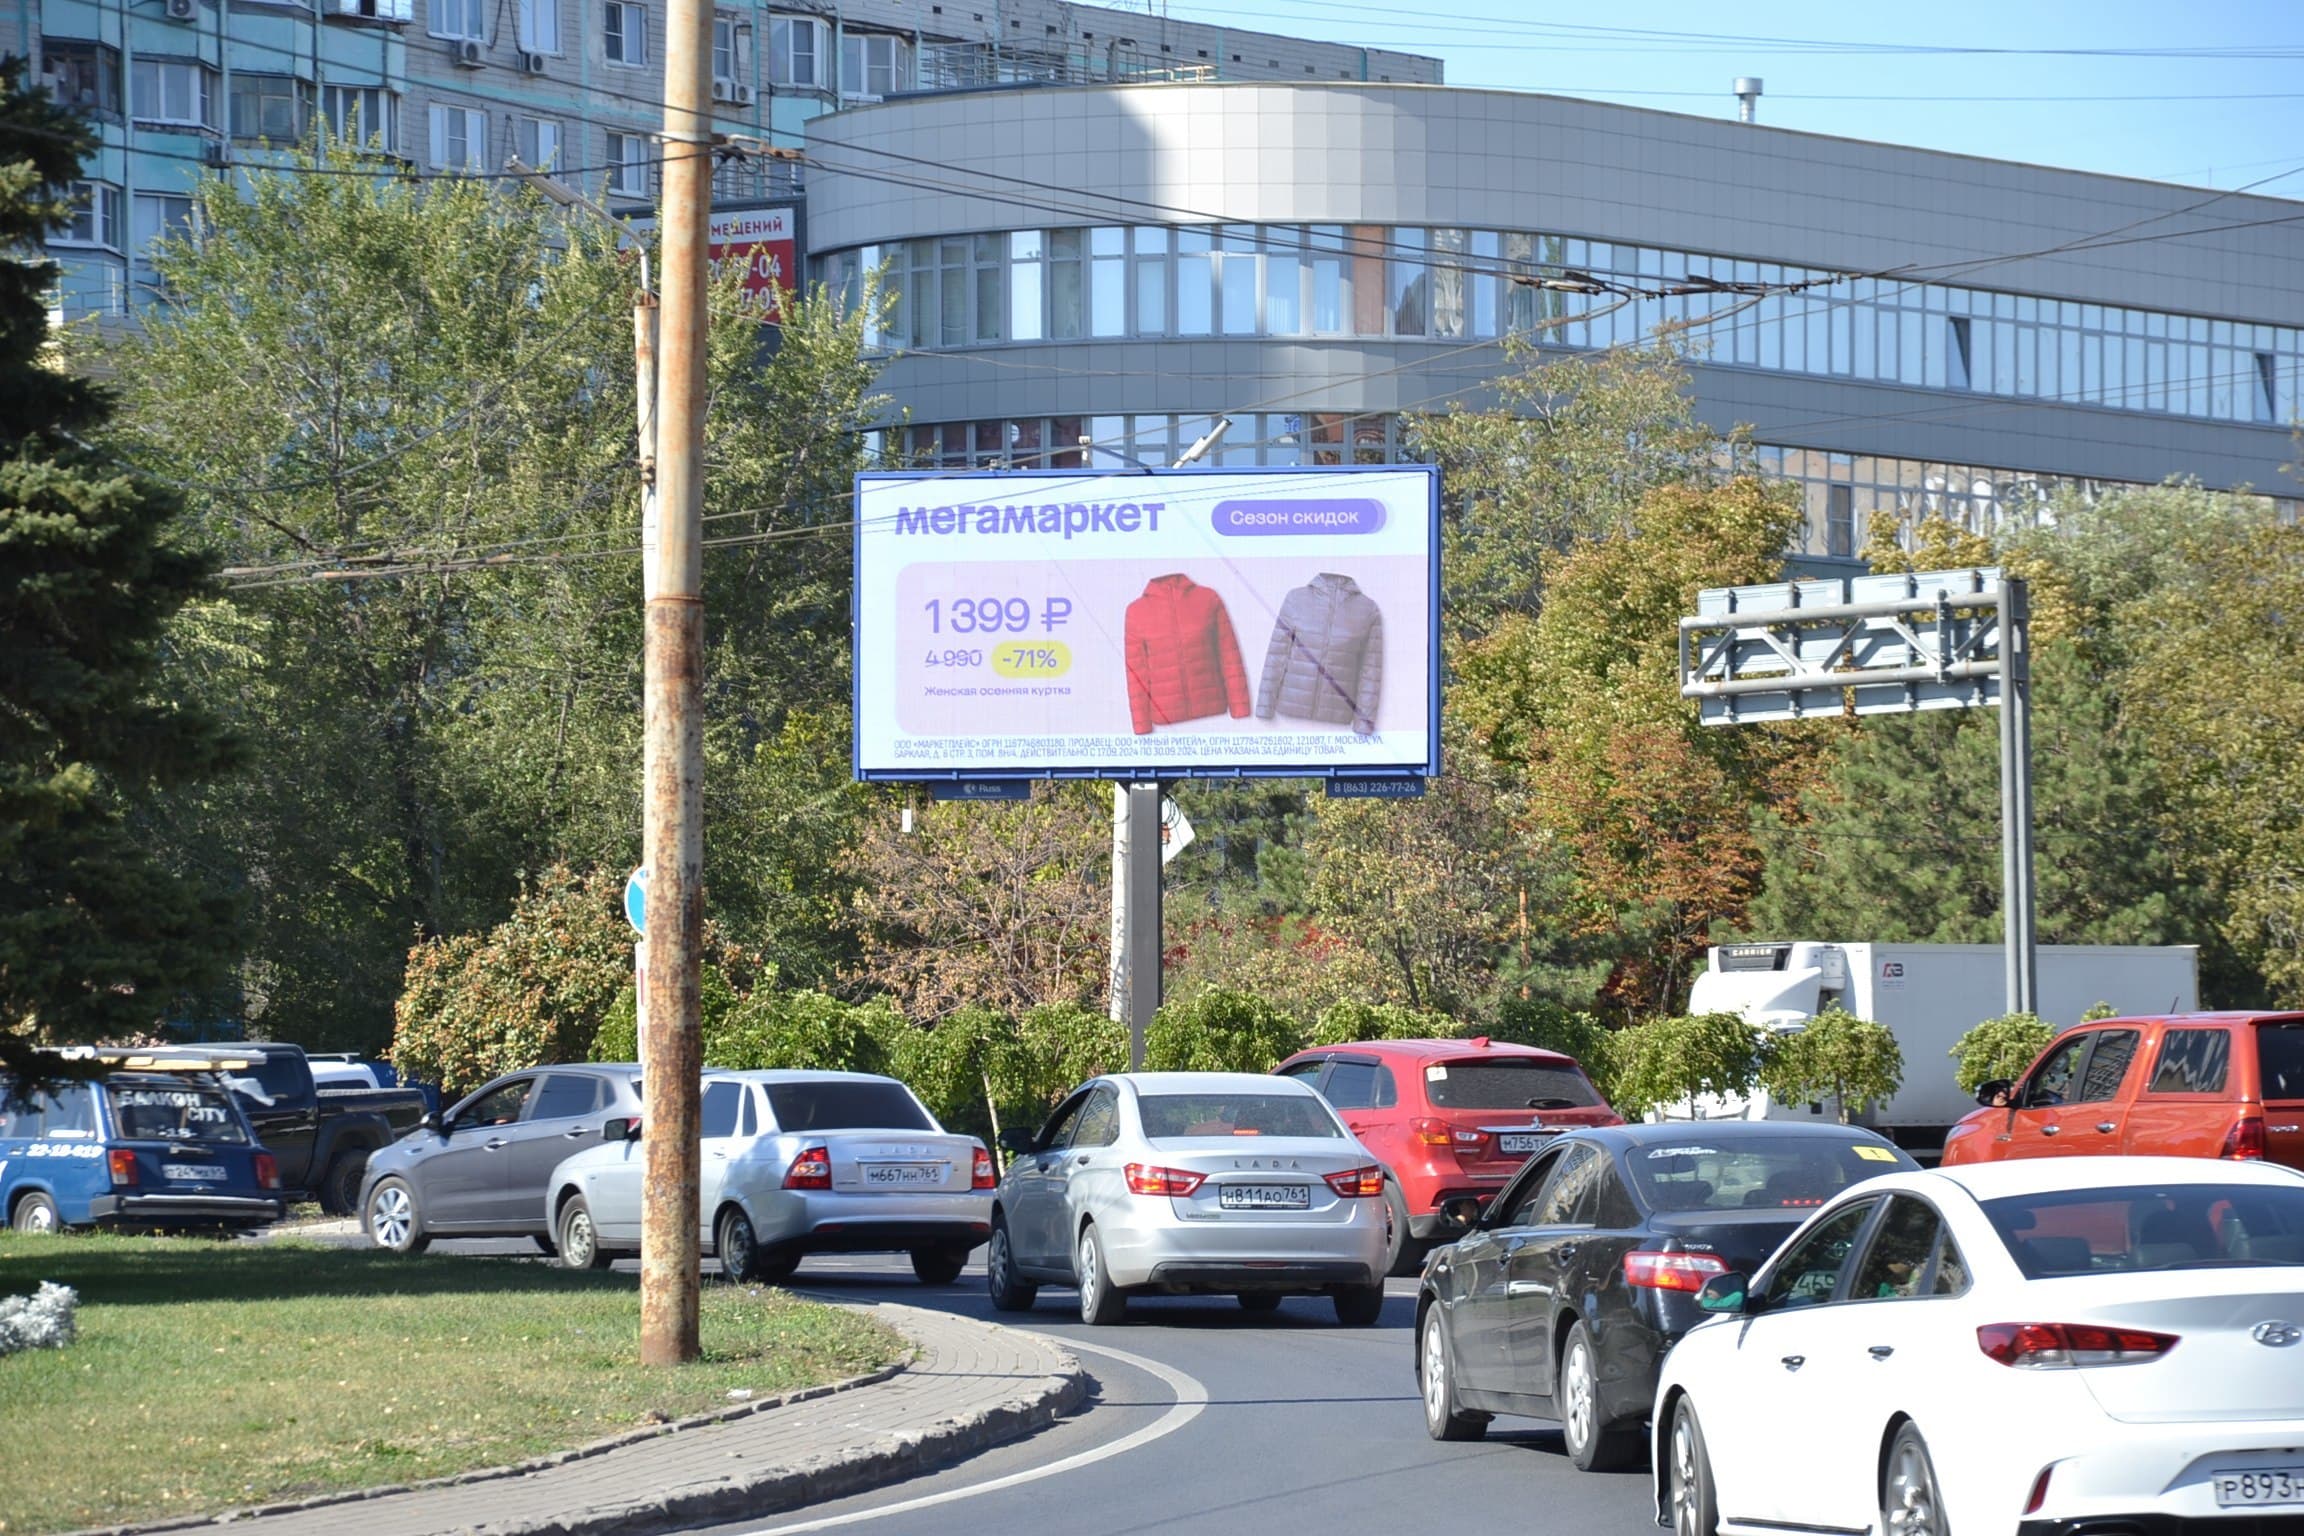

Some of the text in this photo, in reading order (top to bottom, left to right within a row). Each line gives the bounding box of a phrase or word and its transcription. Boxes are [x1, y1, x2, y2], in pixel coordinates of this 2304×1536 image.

[710, 216, 783, 236] МЕЩЕНИЙ
[895, 502, 1165, 539] мегамаркет
[1230, 510, 1359, 527] Сезон скидок
[1002, 649, 1057, 668] -71%
[924, 686, 1072, 697] Женская осенняя куртка
[981, 738, 1002, 748] ОГРН
[1115, 737, 1132, 747] ООО
[1209, 736, 1230, 746] ОГРН
[1140, 747, 1152, 756] ПО
[1200, 746, 1222, 757] ЦЕНА
[1224, 746, 1259, 755] УКАЗАНА
[1261, 746, 1272, 755] ЗА
[978, 783, 1002, 793] Russ
[1334, 782, 1416, 794] 8 (863) 226-77-26
[187, 1106, 228, 1122] CITY
[1233, 1159, 1301, 1169] LADA
